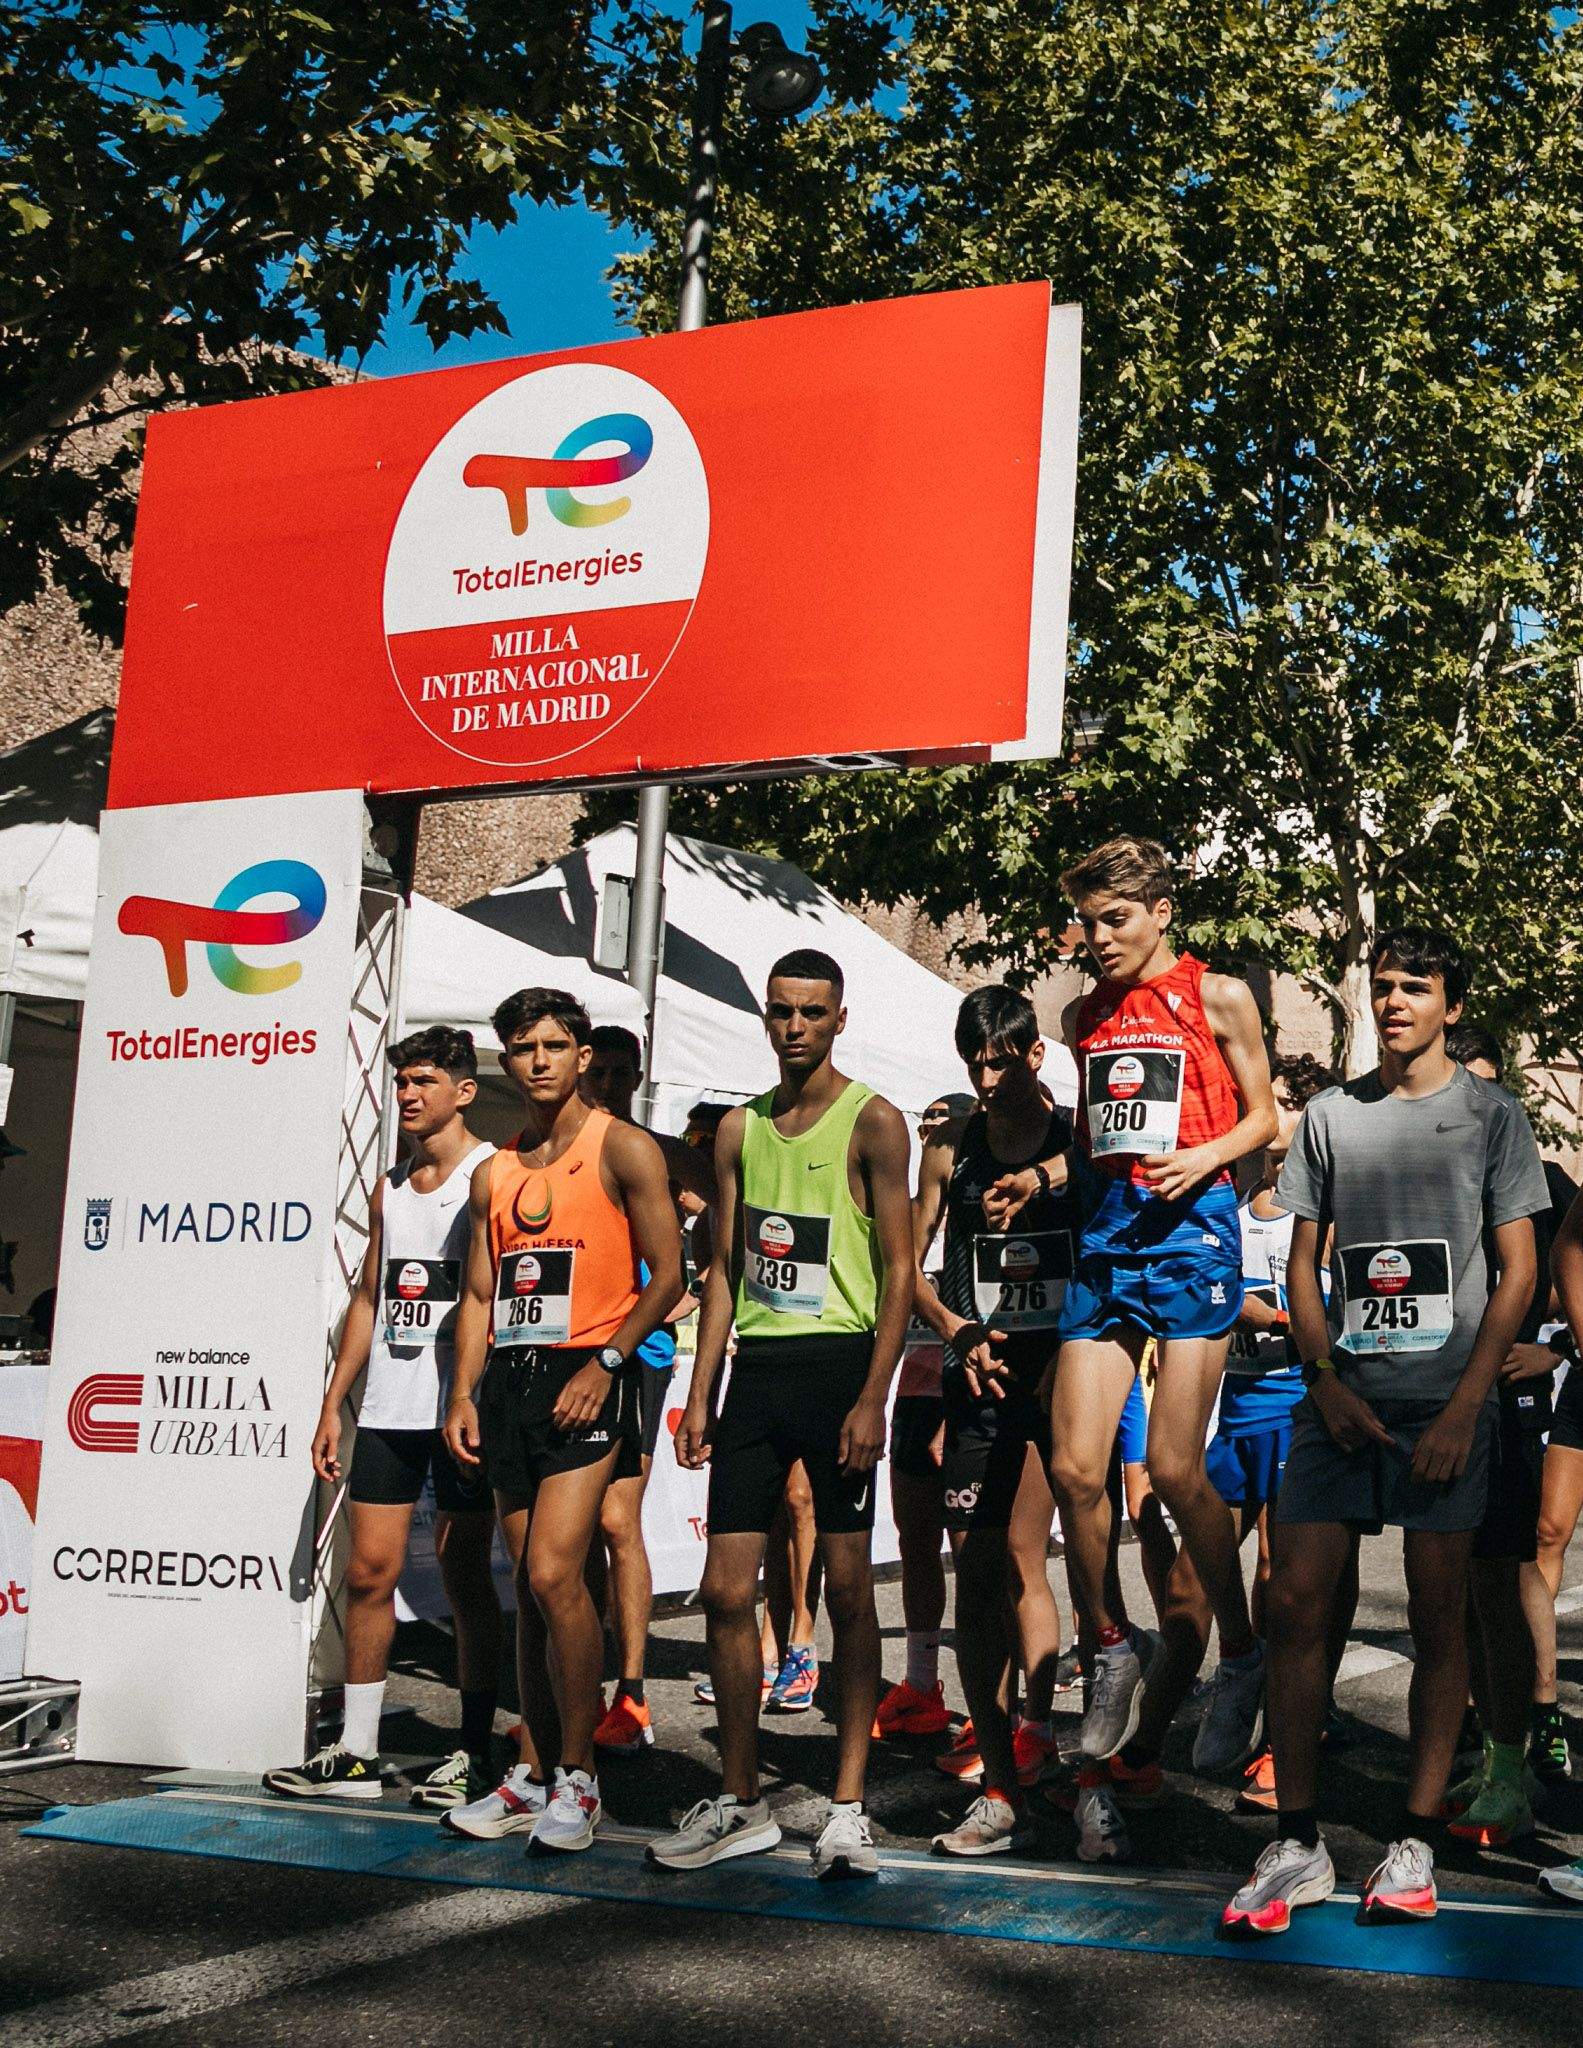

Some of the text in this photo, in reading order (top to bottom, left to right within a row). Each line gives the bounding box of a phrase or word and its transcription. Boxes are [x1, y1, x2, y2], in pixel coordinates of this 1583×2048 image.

[453, 548, 643, 595] TotalEnergies
[490, 624, 580, 659] MILLA
[451, 693, 611, 733] DE MADRID
[106, 1022, 318, 1065] TotalEnergies
[1111, 1033, 1183, 1046] MARATHON
[1102, 1101, 1147, 1134] 260
[138, 1201, 313, 1244] MADRID
[755, 1255, 798, 1292] 239
[391, 1301, 431, 1327] 290
[507, 1296, 543, 1327] 286
[999, 1281, 1047, 1312] 276
[1362, 1297, 1419, 1331] 245
[155, 1348, 250, 1365] new balance
[153, 1375, 272, 1412] MILLA
[149, 1421, 290, 1458] URBANA
